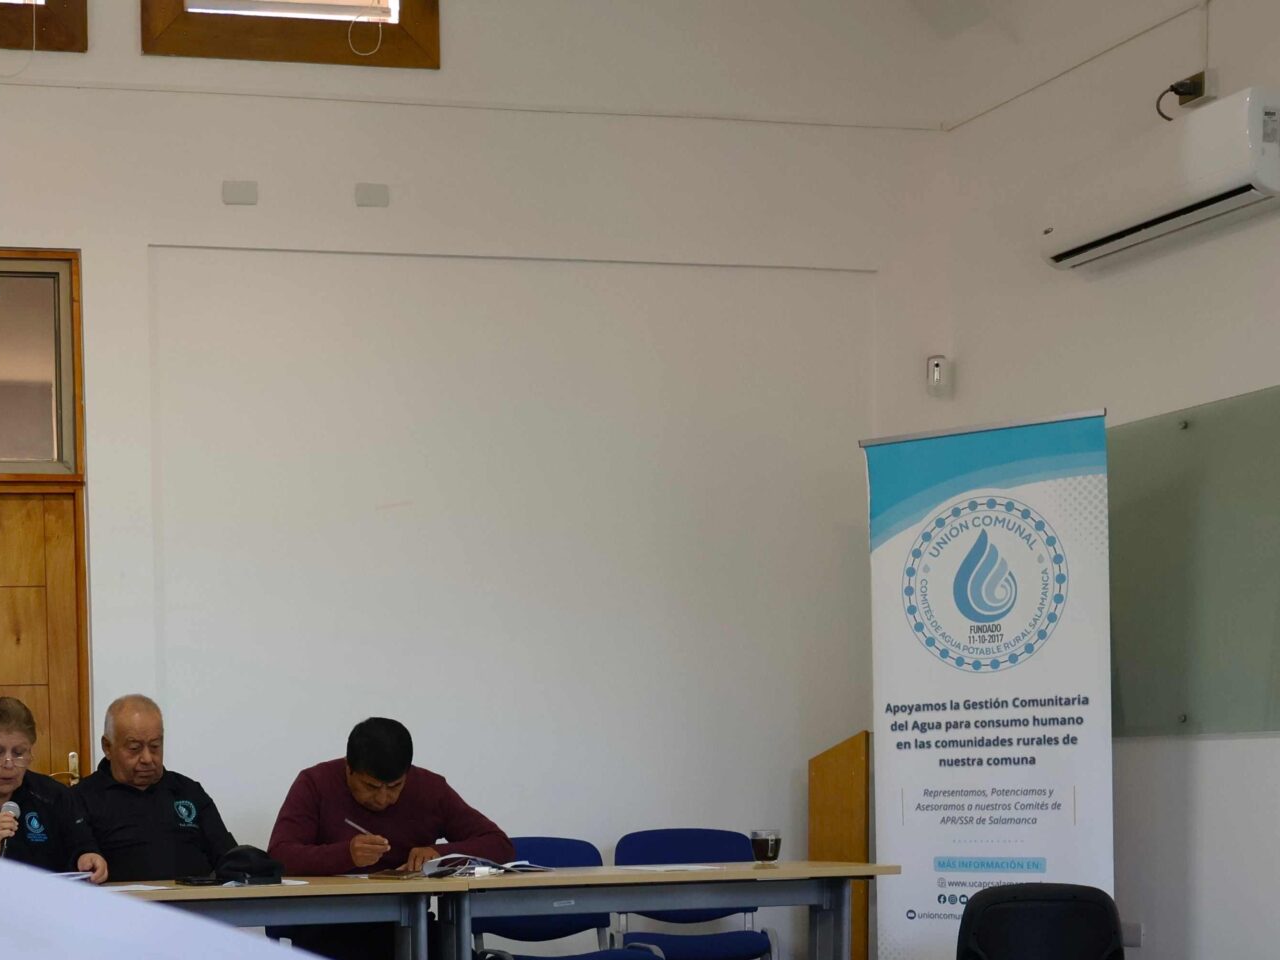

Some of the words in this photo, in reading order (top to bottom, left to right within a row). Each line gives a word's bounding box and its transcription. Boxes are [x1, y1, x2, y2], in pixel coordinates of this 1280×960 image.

[929, 520, 970, 558] UNIÓN
[971, 515, 1037, 551] COMUNAL
[930, 620, 943, 634] DE
[939, 631, 965, 650] AGUA
[962, 645, 1002, 656] POTABLE
[1003, 628, 1032, 650] RURAL
[1029, 568, 1050, 630] SALAMANCA
[970, 624, 1002, 634] FUNDADO
[968, 634, 1004, 645] 11-10-2017
[885, 702, 948, 716] Apoyamos
[950, 699, 961, 711] la
[963, 697, 1009, 711] Gestión
[1012, 694, 1090, 709] Comunitaria
[890, 720, 908, 732] del
[911, 719, 942, 734] Agua
[945, 720, 971, 733] para
[973, 717, 1030, 729] consumo
[1032, 714, 1085, 728] humano
[896, 740, 911, 750] en
[914, 738, 932, 750] las
[934, 735, 1014, 749] comunidades
[1016, 734, 1060, 747] rurales
[1062, 733, 1078, 746] de
[938, 756, 984, 768] nuestra
[986, 754, 1036, 766] comuna
[922, 788, 988, 800] Representamos,
[990, 787, 1047, 798] Potenciamos
[1048, 788, 1055, 799] y
[915, 802, 966, 812] Asesoramos
[967, 803, 974, 811] a
[975, 801, 1012, 811] nuestros
[1014, 800, 1049, 811] Comités
[1051, 800, 1062, 811] de
[939, 815, 974, 825] APR/SSR
[975, 815, 987, 825] de
[988, 815, 1038, 825] Salamanca
[937, 859, 957, 870] MÁS
[958, 859, 1024, 870] INFORMACIÓN
